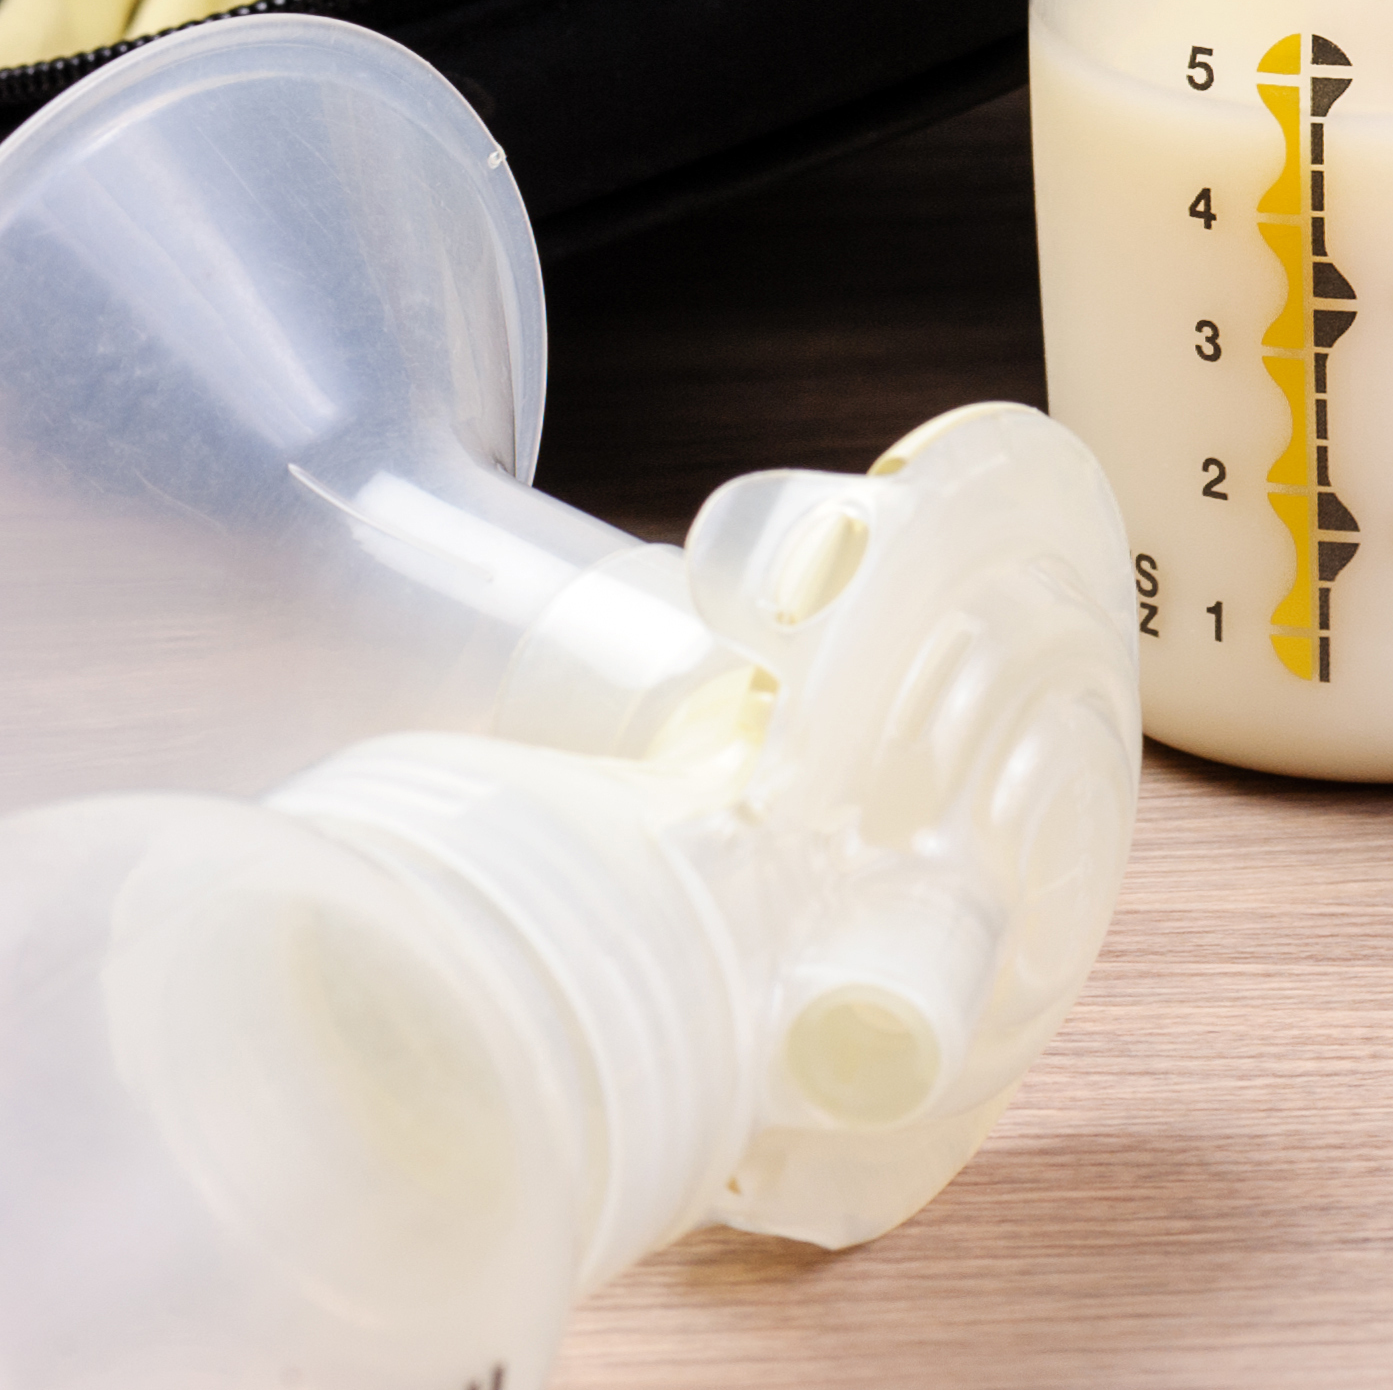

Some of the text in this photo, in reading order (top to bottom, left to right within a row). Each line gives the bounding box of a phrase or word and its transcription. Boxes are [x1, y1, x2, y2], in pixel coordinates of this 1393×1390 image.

[1187, 46, 1215, 92] 5
[1189, 188, 1217, 230] 4
[1195, 320, 1222, 362] 3
[1202, 458, 1228, 501] 2
[1130, 551, 1159, 599] S
[1139, 601, 1160, 638] z
[1206, 601, 1223, 642] 1
